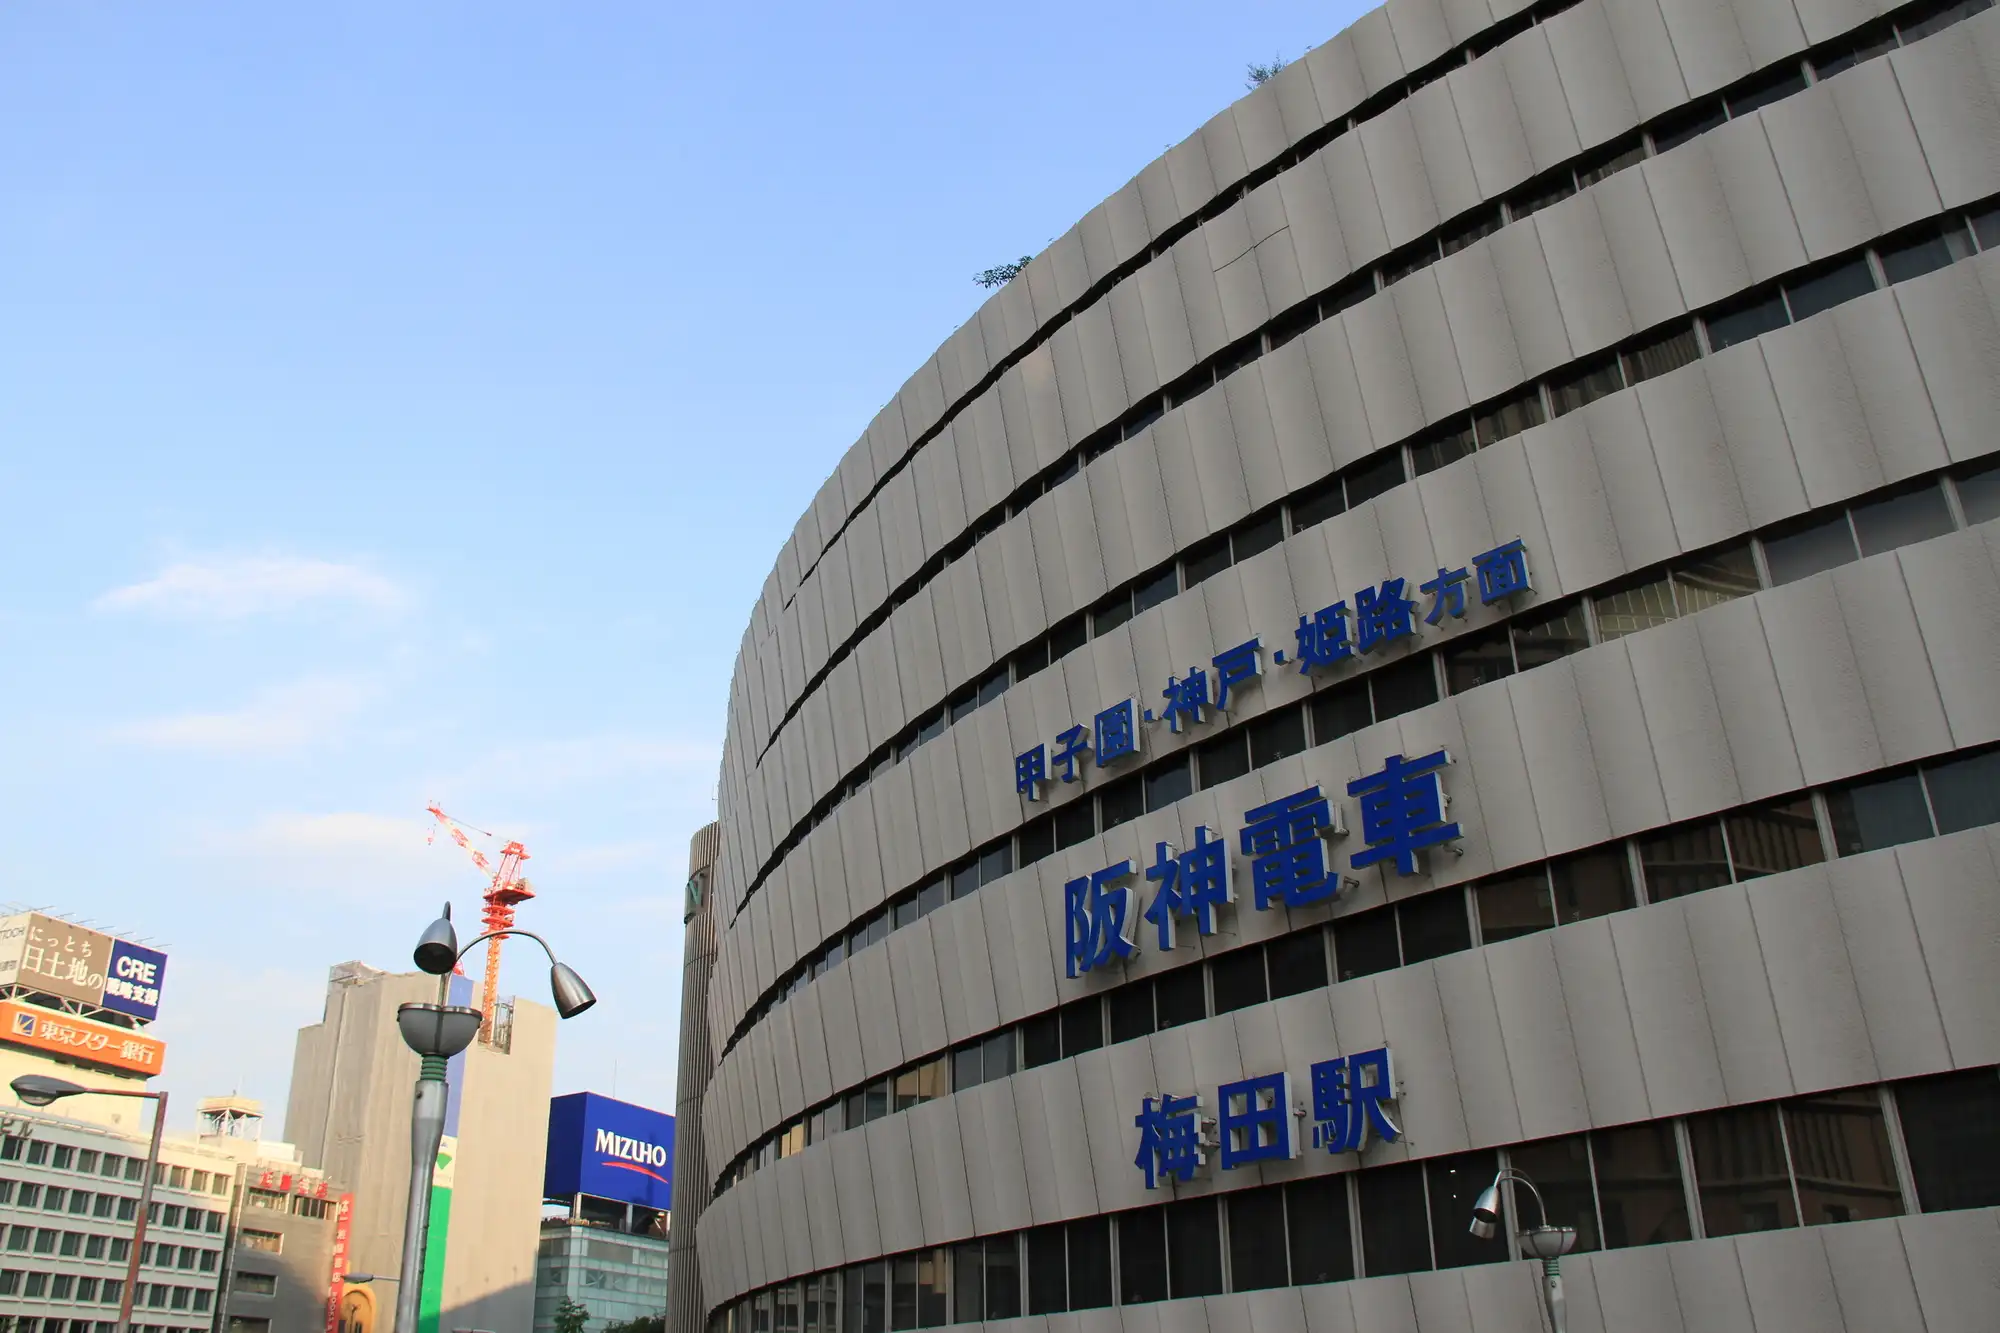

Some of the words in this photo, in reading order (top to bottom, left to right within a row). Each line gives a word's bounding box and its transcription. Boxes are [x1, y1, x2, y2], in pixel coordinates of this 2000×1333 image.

[1064, 750, 1463, 980] 阪神電車
[29, 926, 92, 958] にっとち
[21, 944, 103, 990] 日土地の
[116, 955, 157, 984] CRE
[40, 1020, 156, 1065] 東京スター銀行
[1135, 1047, 1399, 1190] 梅田駅
[595, 1128, 667, 1168] MIZUHO
